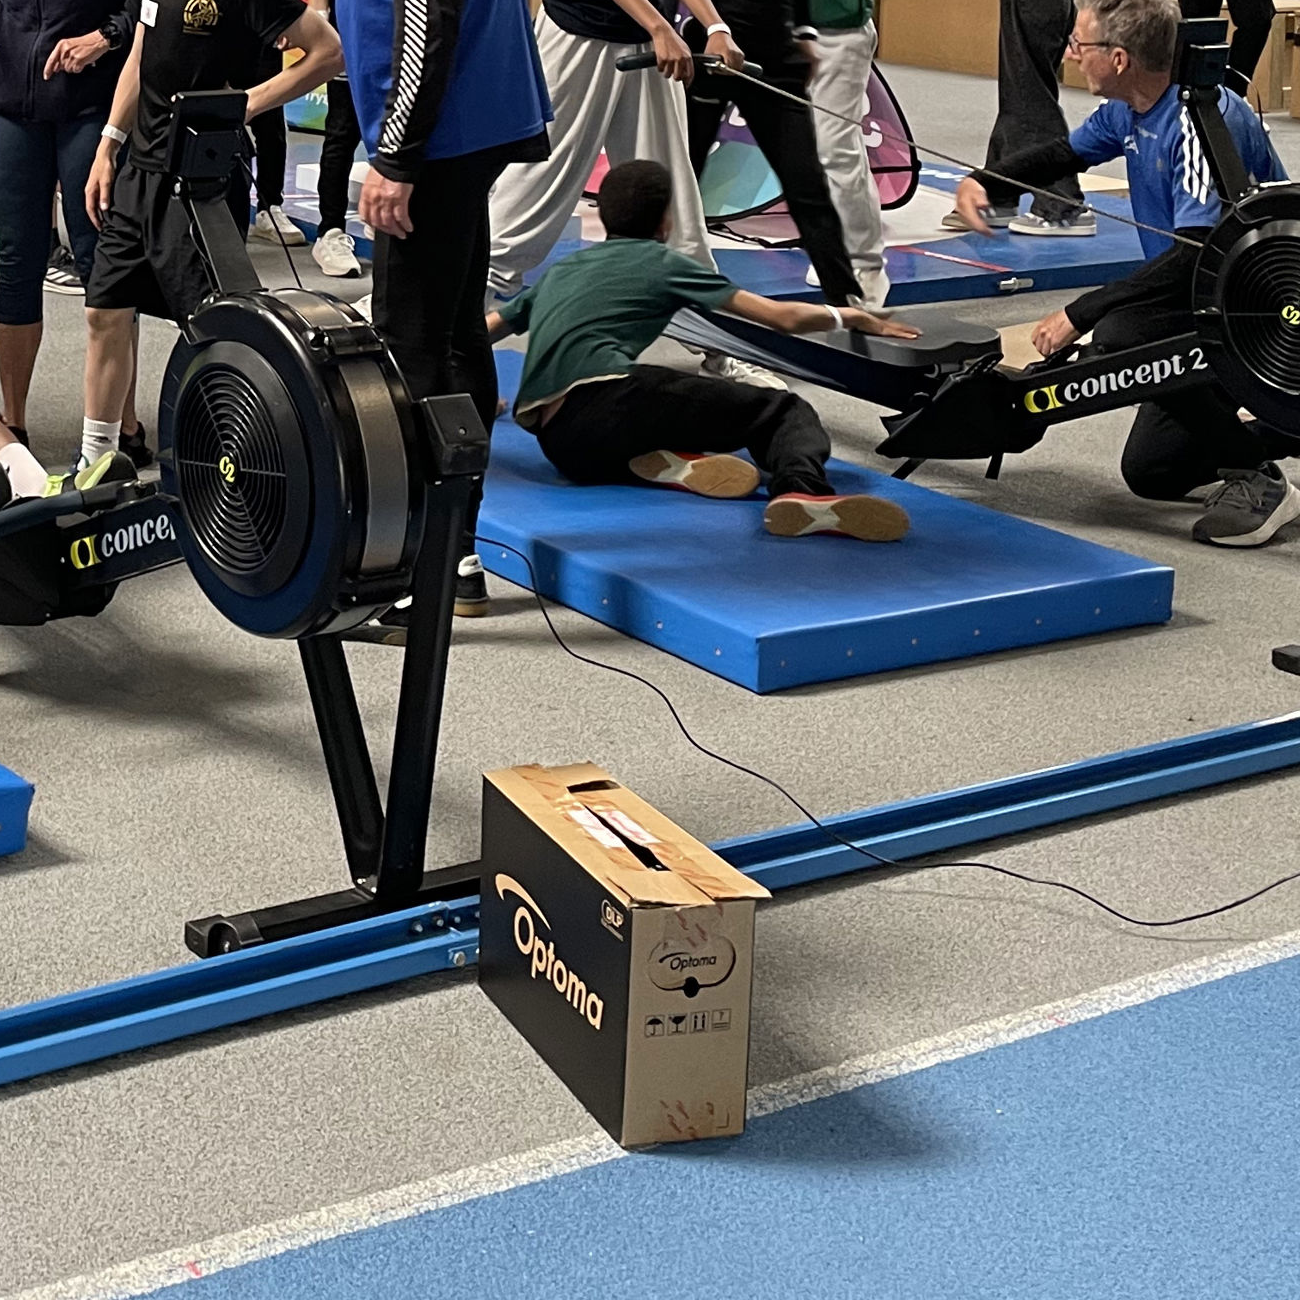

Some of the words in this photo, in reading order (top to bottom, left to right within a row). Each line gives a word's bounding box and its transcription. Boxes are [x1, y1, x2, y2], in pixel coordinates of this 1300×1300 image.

[1064, 354, 1185, 403] concept
[1189, 347, 1209, 370] 2
[219, 455, 236, 484] C2
[514, 906, 604, 1030] Optoma
[670, 955, 717, 973] Optoma
